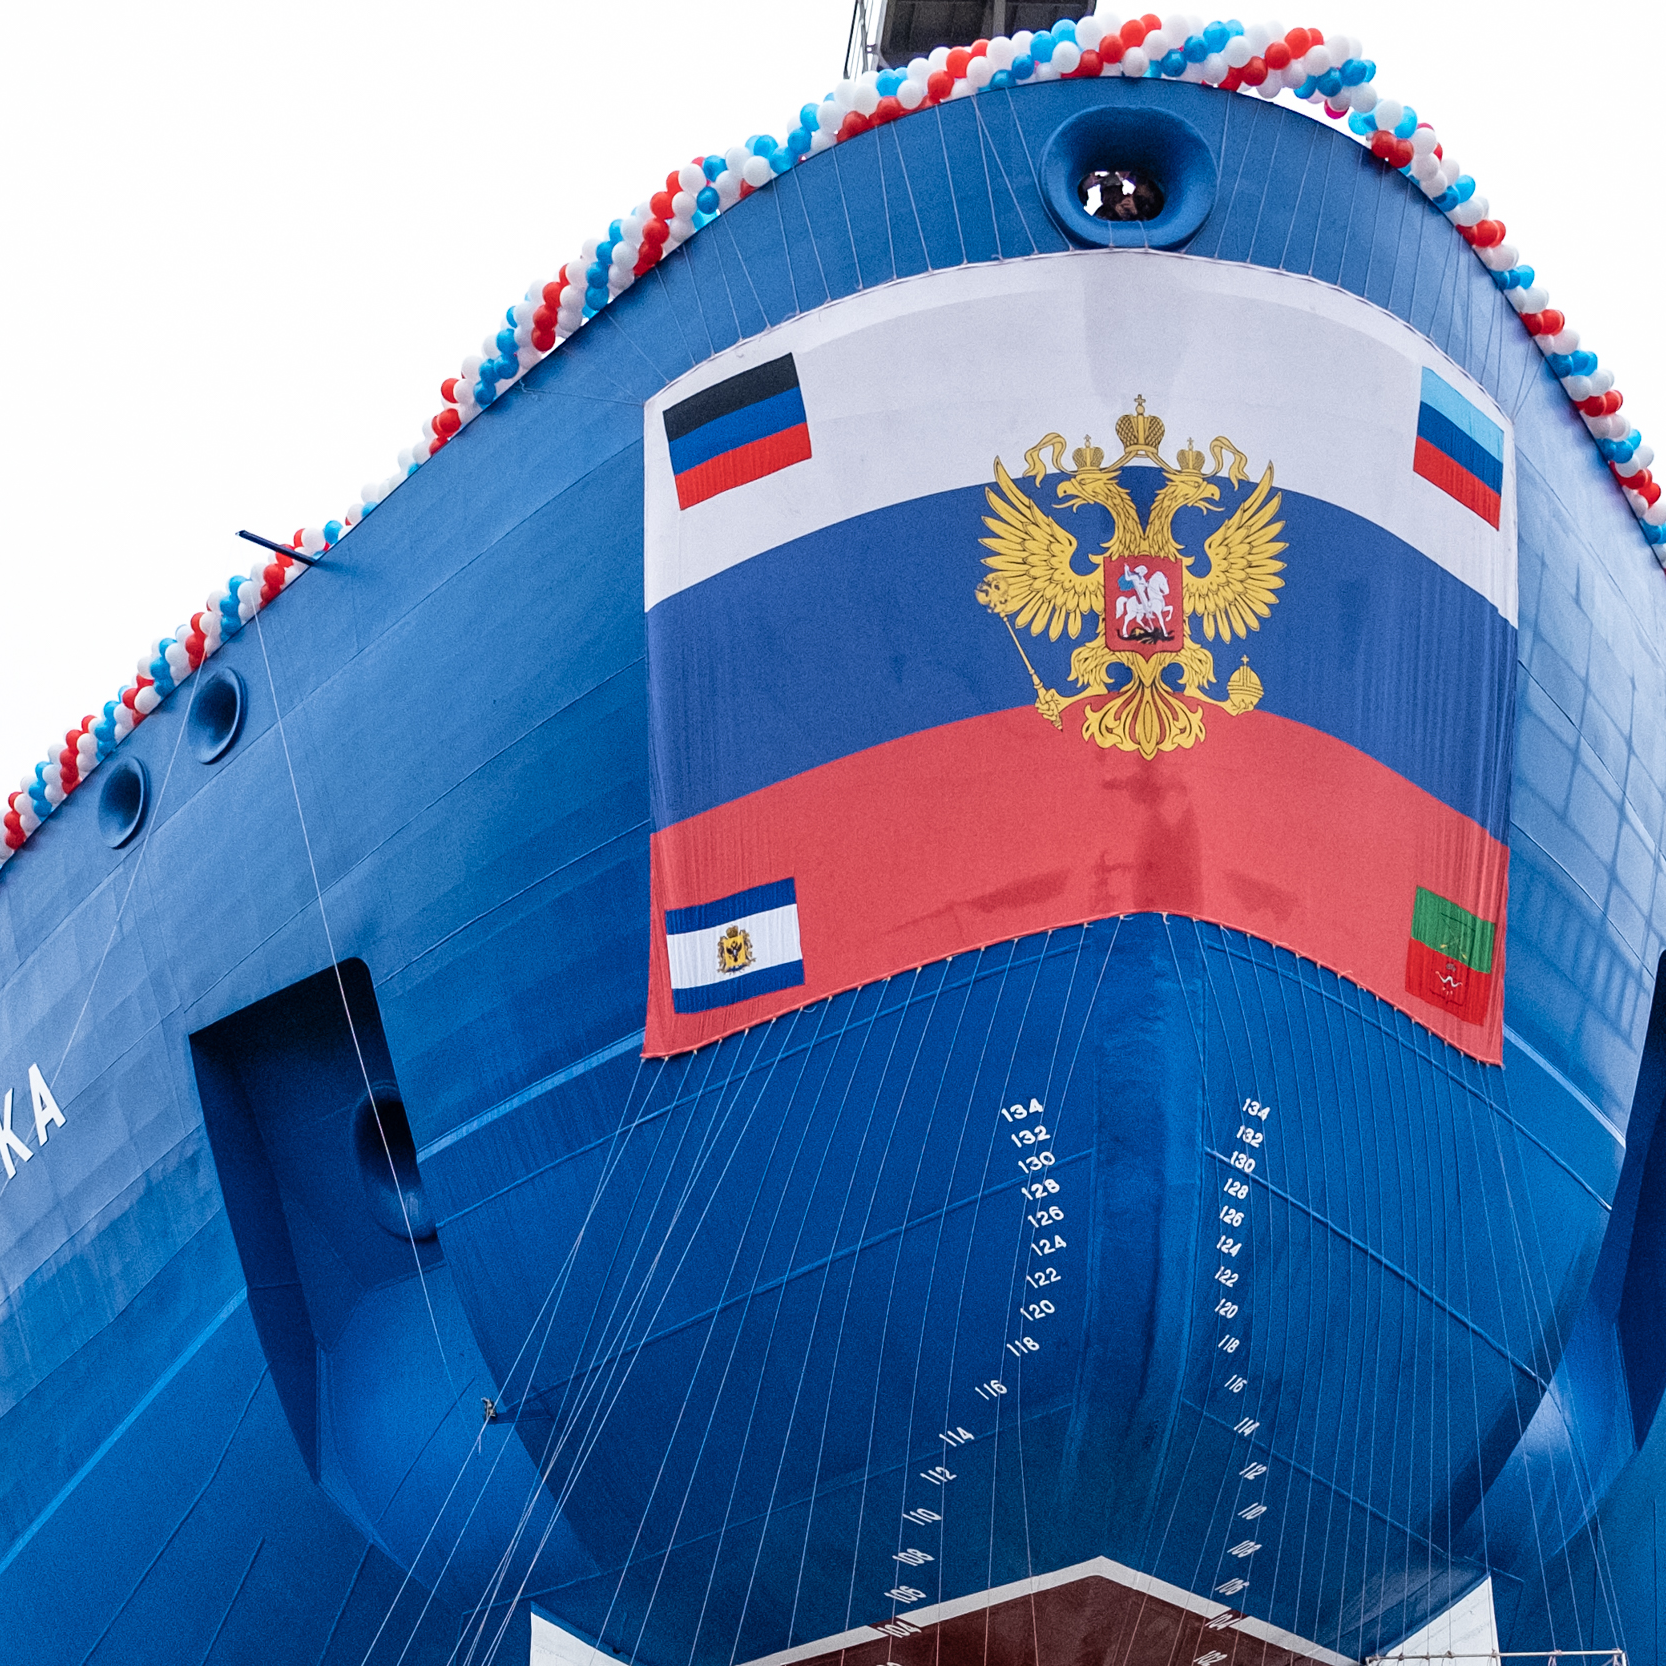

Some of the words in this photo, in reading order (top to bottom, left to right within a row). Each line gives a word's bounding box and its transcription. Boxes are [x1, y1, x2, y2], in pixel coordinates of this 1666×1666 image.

[1001, 1098, 1044, 1122] 134
[1242, 1098, 1270, 1121] 134
[1011, 1126, 1050, 1148] 132
[1236, 1125, 1263, 1148] 132
[1018, 1151, 1055, 1174] 130
[1230, 1151, 1255, 1174] 130
[1021, 1179, 1060, 1201] 128
[1223, 1178, 1249, 1200] 128
[1028, 1206, 1064, 1228] 126
[1218, 1206, 1245, 1227] 126
[1031, 1235, 1066, 1257] 124
[1216, 1235, 1241, 1257] 124
[1026, 1267, 1061, 1289] 122
[1215, 1266, 1239, 1288] 122
[1020, 1300, 1055, 1321] 120
[1215, 1299, 1238, 1319] 120
[1007, 1336, 1039, 1357] 118
[1218, 1335, 1240, 1354] 118
[975, 1379, 1007, 1400] 116
[1224, 1375, 1247, 1393] 116
[939, 1426, 974, 1448] 114
[1234, 1417, 1260, 1437] 114
[920, 1465, 956, 1485] 112
[1239, 1462, 1267, 1480] 112
[903, 1508, 942, 1526] 110
[1237, 1503, 1267, 1520] 110
[892, 1549, 935, 1566] 108
[1227, 1540, 1262, 1558] 108
[884, 1586, 926, 1603] 106
[1215, 1578, 1250, 1595] 106
[878, 1621, 922, 1638] 104
[1193, 1650, 1227, 1666] 102
